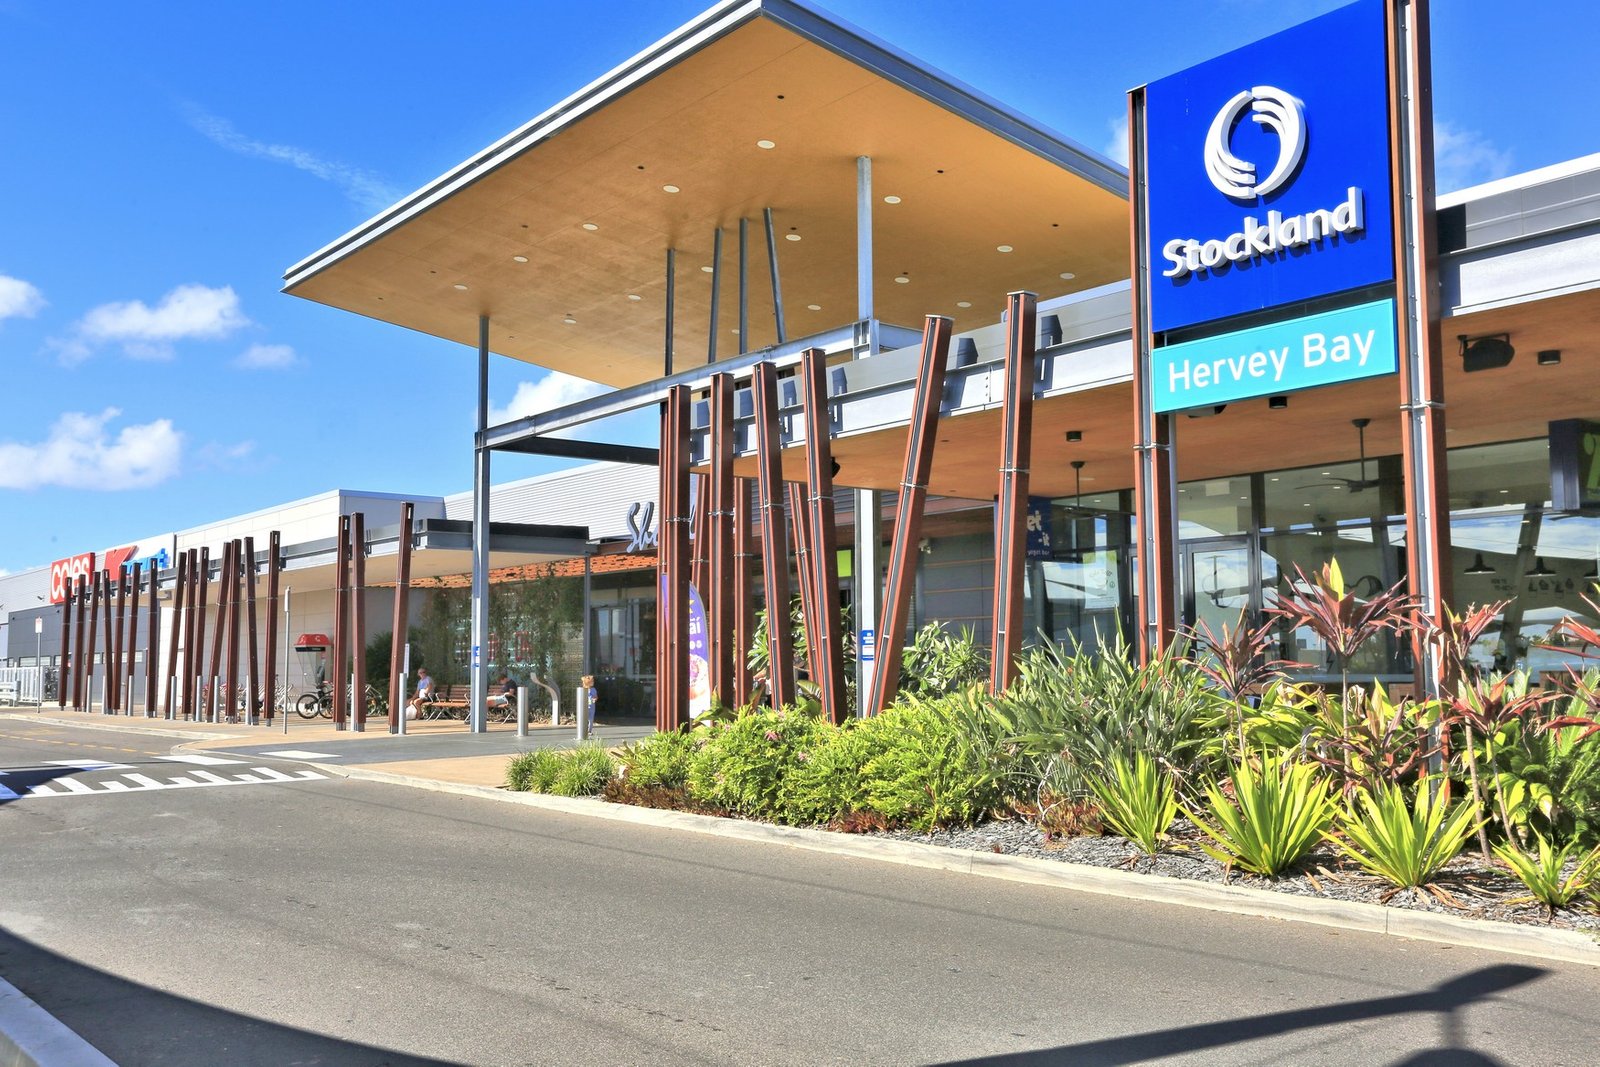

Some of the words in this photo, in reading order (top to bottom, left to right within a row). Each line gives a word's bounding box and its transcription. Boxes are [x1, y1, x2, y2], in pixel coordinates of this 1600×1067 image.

[1162, 186, 1362, 277] Stockland
[1169, 346, 1289, 392] Hervey
[1303, 329, 1375, 367] Bay
[51, 557, 89, 600] coles
